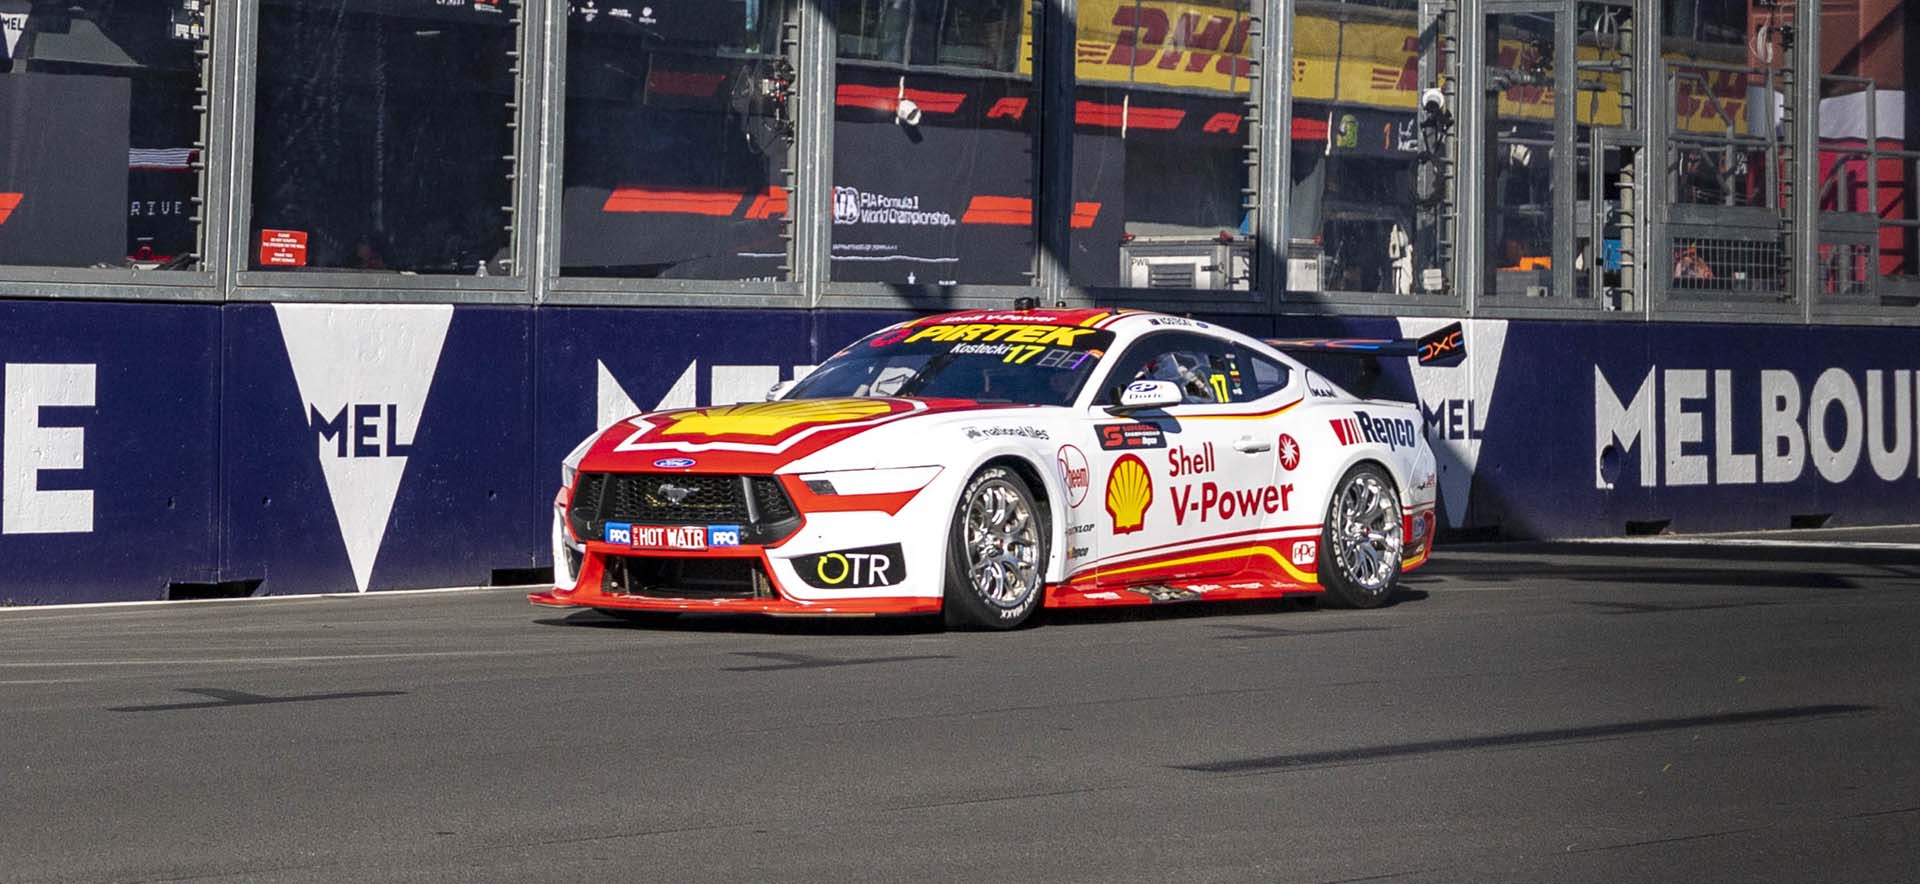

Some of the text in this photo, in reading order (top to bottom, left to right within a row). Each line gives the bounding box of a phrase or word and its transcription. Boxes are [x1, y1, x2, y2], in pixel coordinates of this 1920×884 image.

[3, 15, 24, 31] MEL
[861, 192, 919, 209] FIA Formula 1
[861, 208, 950, 226] World Championship
[903, 323, 1097, 347] PIRTEK
[950, 342, 1047, 364] Kostecki 17
[1209, 374, 1230, 403] 17
[310, 402, 414, 458] MEL
[1353, 411, 1415, 452] Repco
[1421, 398, 1486, 441] MEL
[1595, 365, 1920, 490] MELBOU
[982, 425, 1050, 441] national tiles
[1168, 441, 1216, 477] Shell
[1058, 446, 1089, 497] Rheem
[1169, 481, 1294, 526] V-Power
[609, 529, 631, 543] PPQ
[640, 528, 705, 549] HOT WATR
[712, 531, 739, 545] PPQ
[1294, 543, 1316, 562] PPG
[817, 552, 889, 586] OTR
